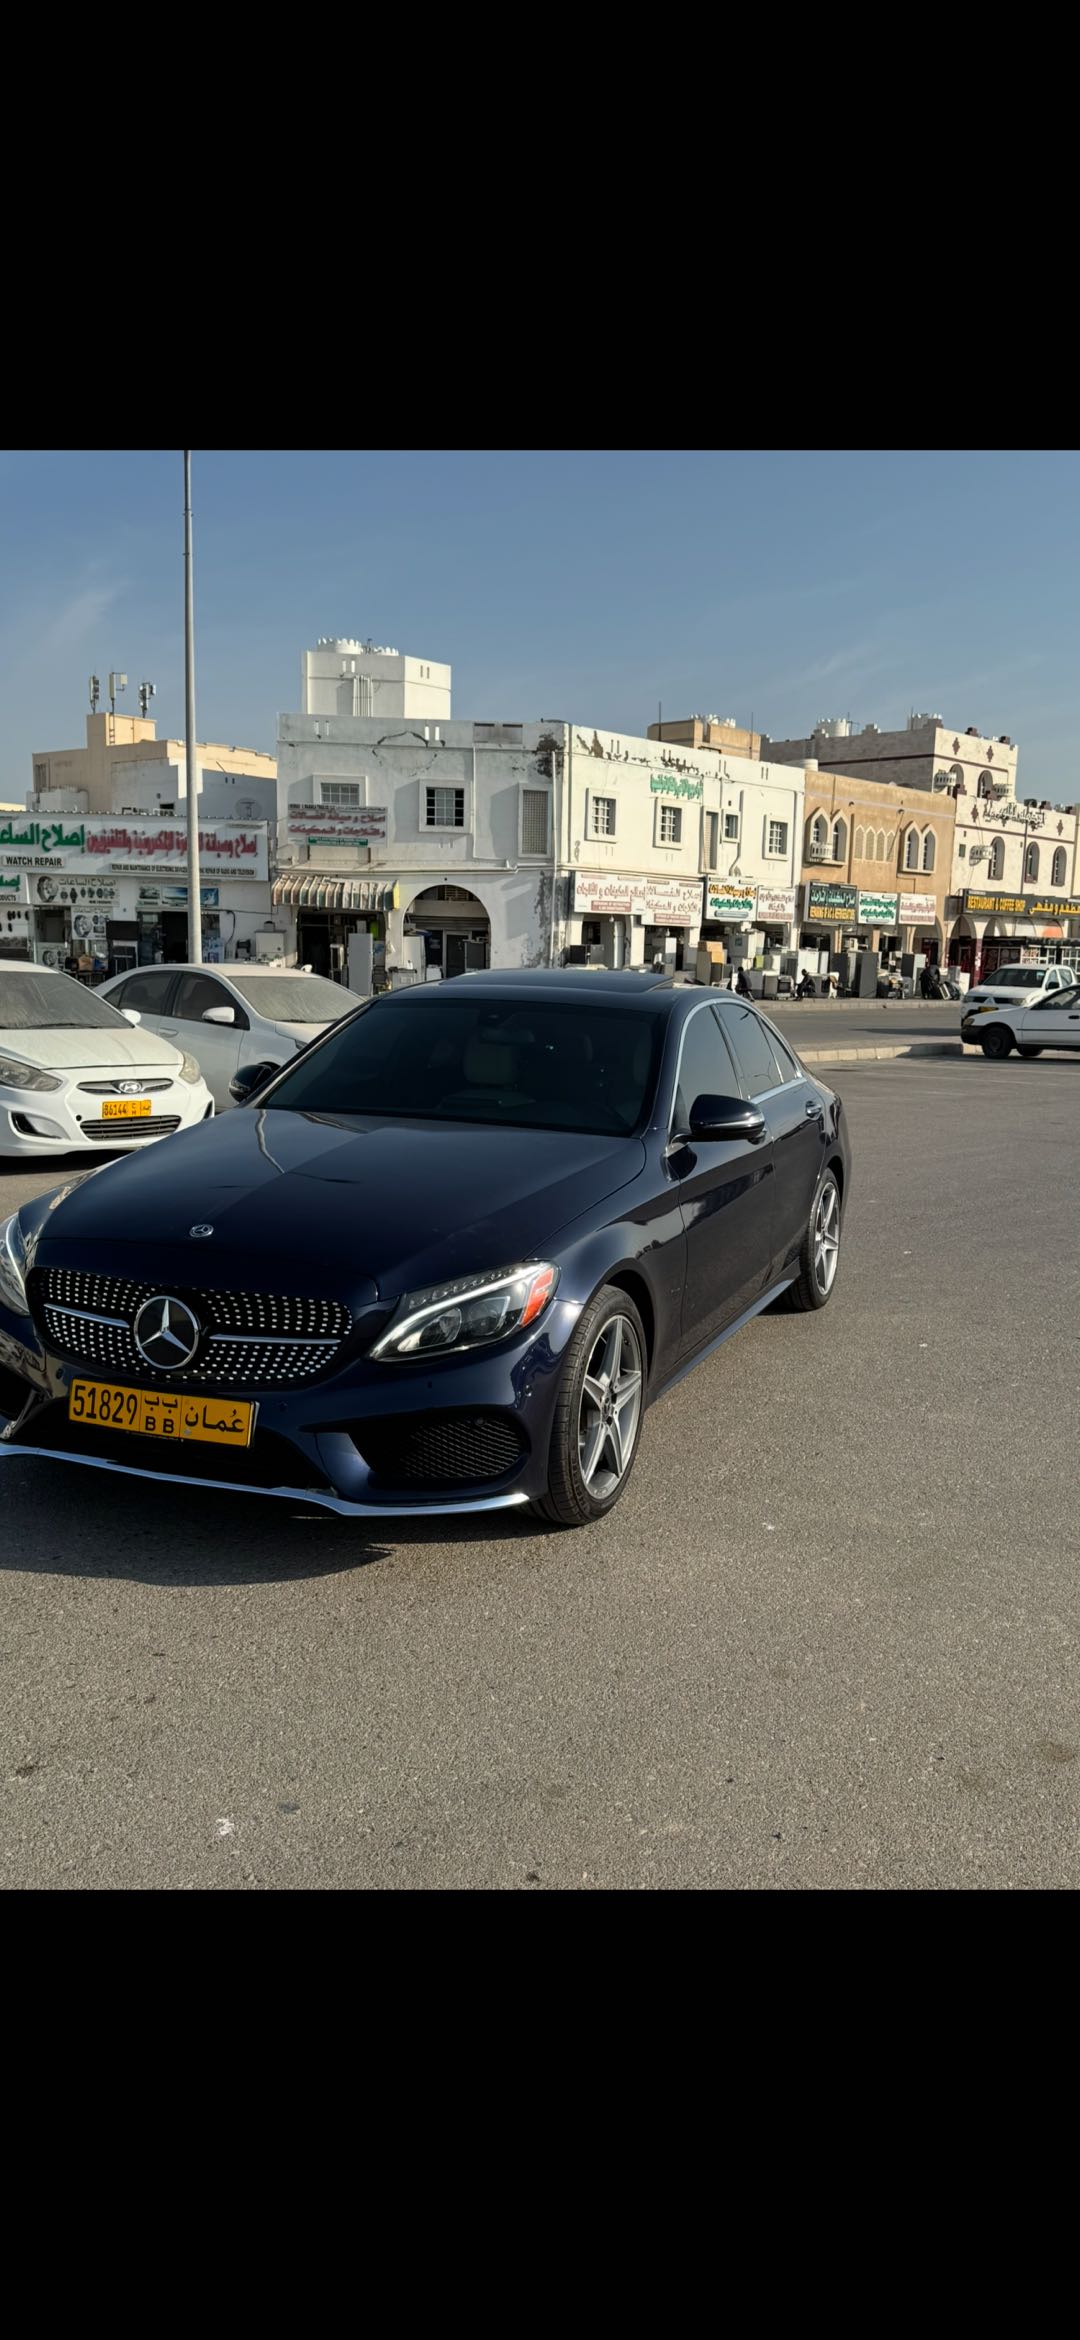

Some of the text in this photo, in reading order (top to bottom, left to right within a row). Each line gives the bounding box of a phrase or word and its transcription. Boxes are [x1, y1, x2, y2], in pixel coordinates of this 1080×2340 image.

[42, 823, 85, 854] إصلاح
[6, 856, 63, 867] WATCH REPAIR
[967, 895, 995, 911] RESTAURANT
[999, 897, 1015, 912] COFFEE
[1015, 899, 1026, 912] SHOP
[73, 1384, 138, 1425] 51829
[145, 1416, 175, 1435] B B
